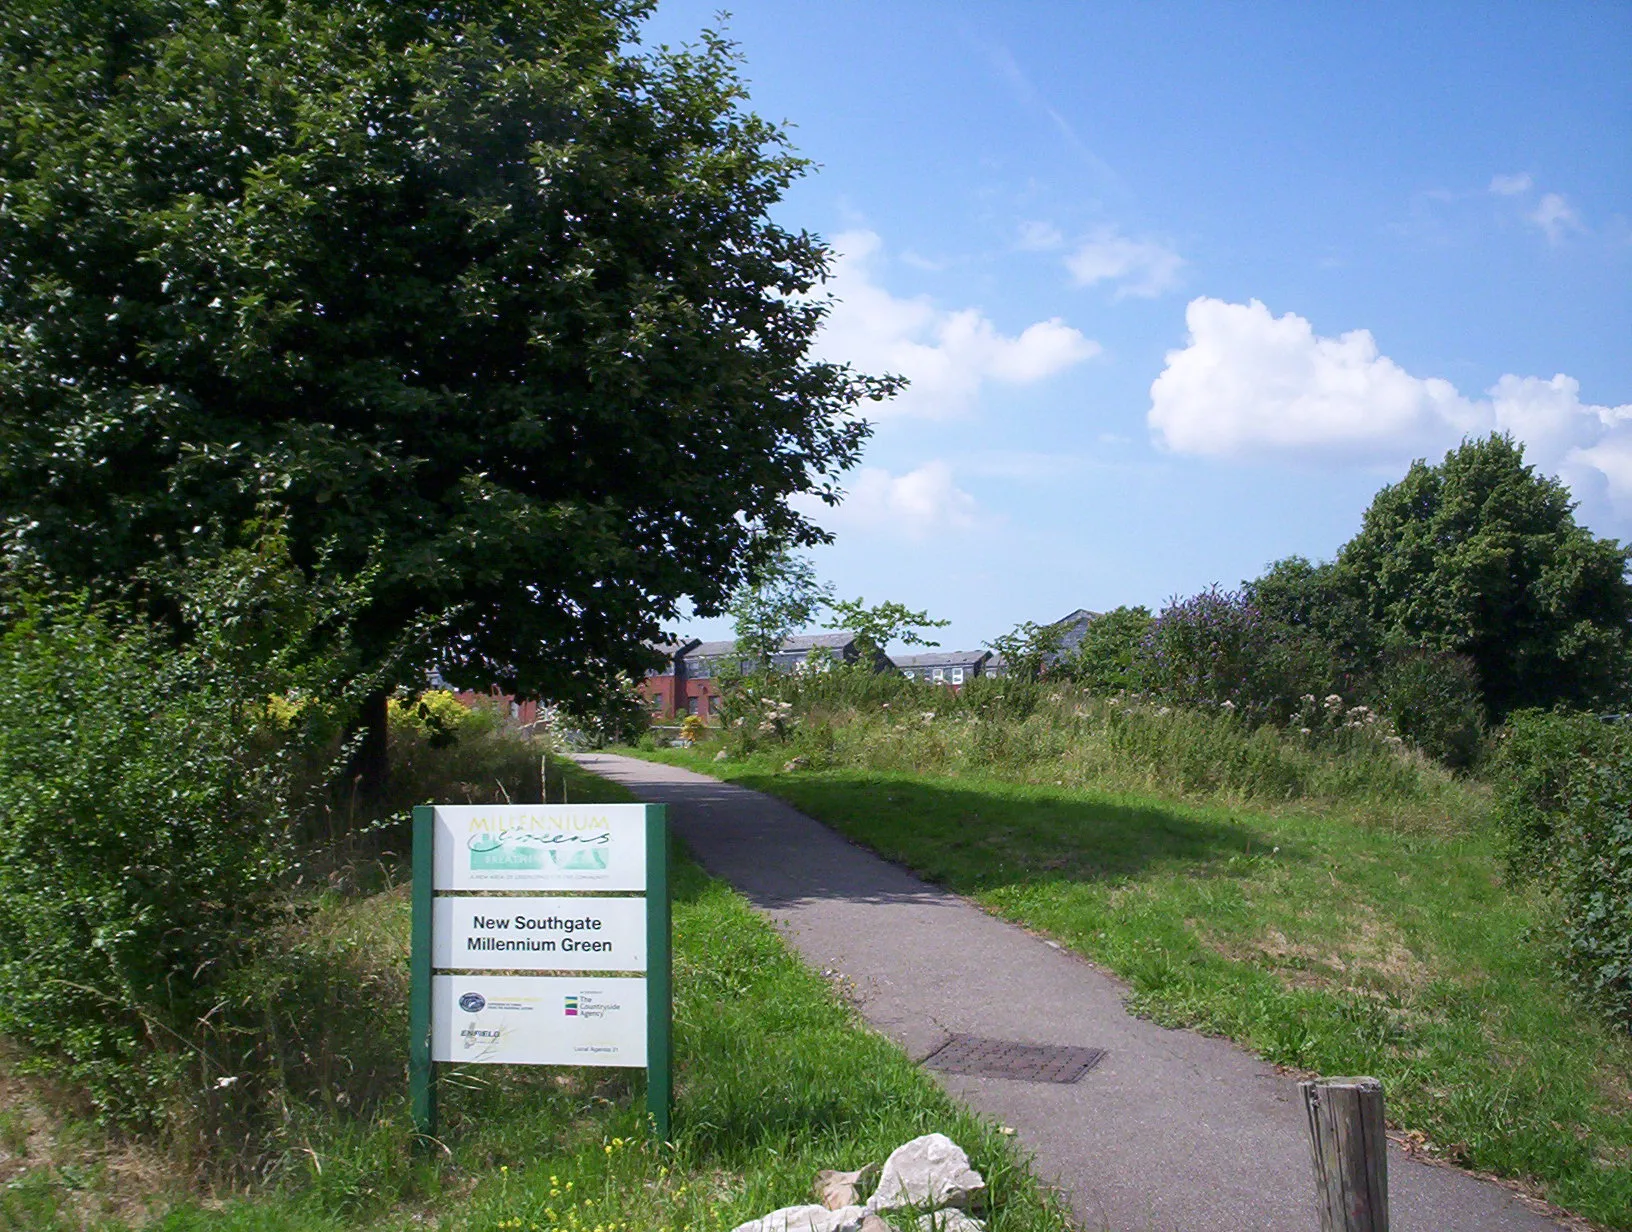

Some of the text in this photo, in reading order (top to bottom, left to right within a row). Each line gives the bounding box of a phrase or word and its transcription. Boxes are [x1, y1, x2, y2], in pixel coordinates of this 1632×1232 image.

[469, 813, 610, 832] MILLENNIUM
[467, 826, 614, 852] Greens
[473, 915, 602, 933] New Southgate
[467, 937, 612, 952] Millennium Green
[579, 995, 592, 1003] The
[579, 1003, 621, 1012] Countryside
[579, 1009, 604, 1018] Agency
